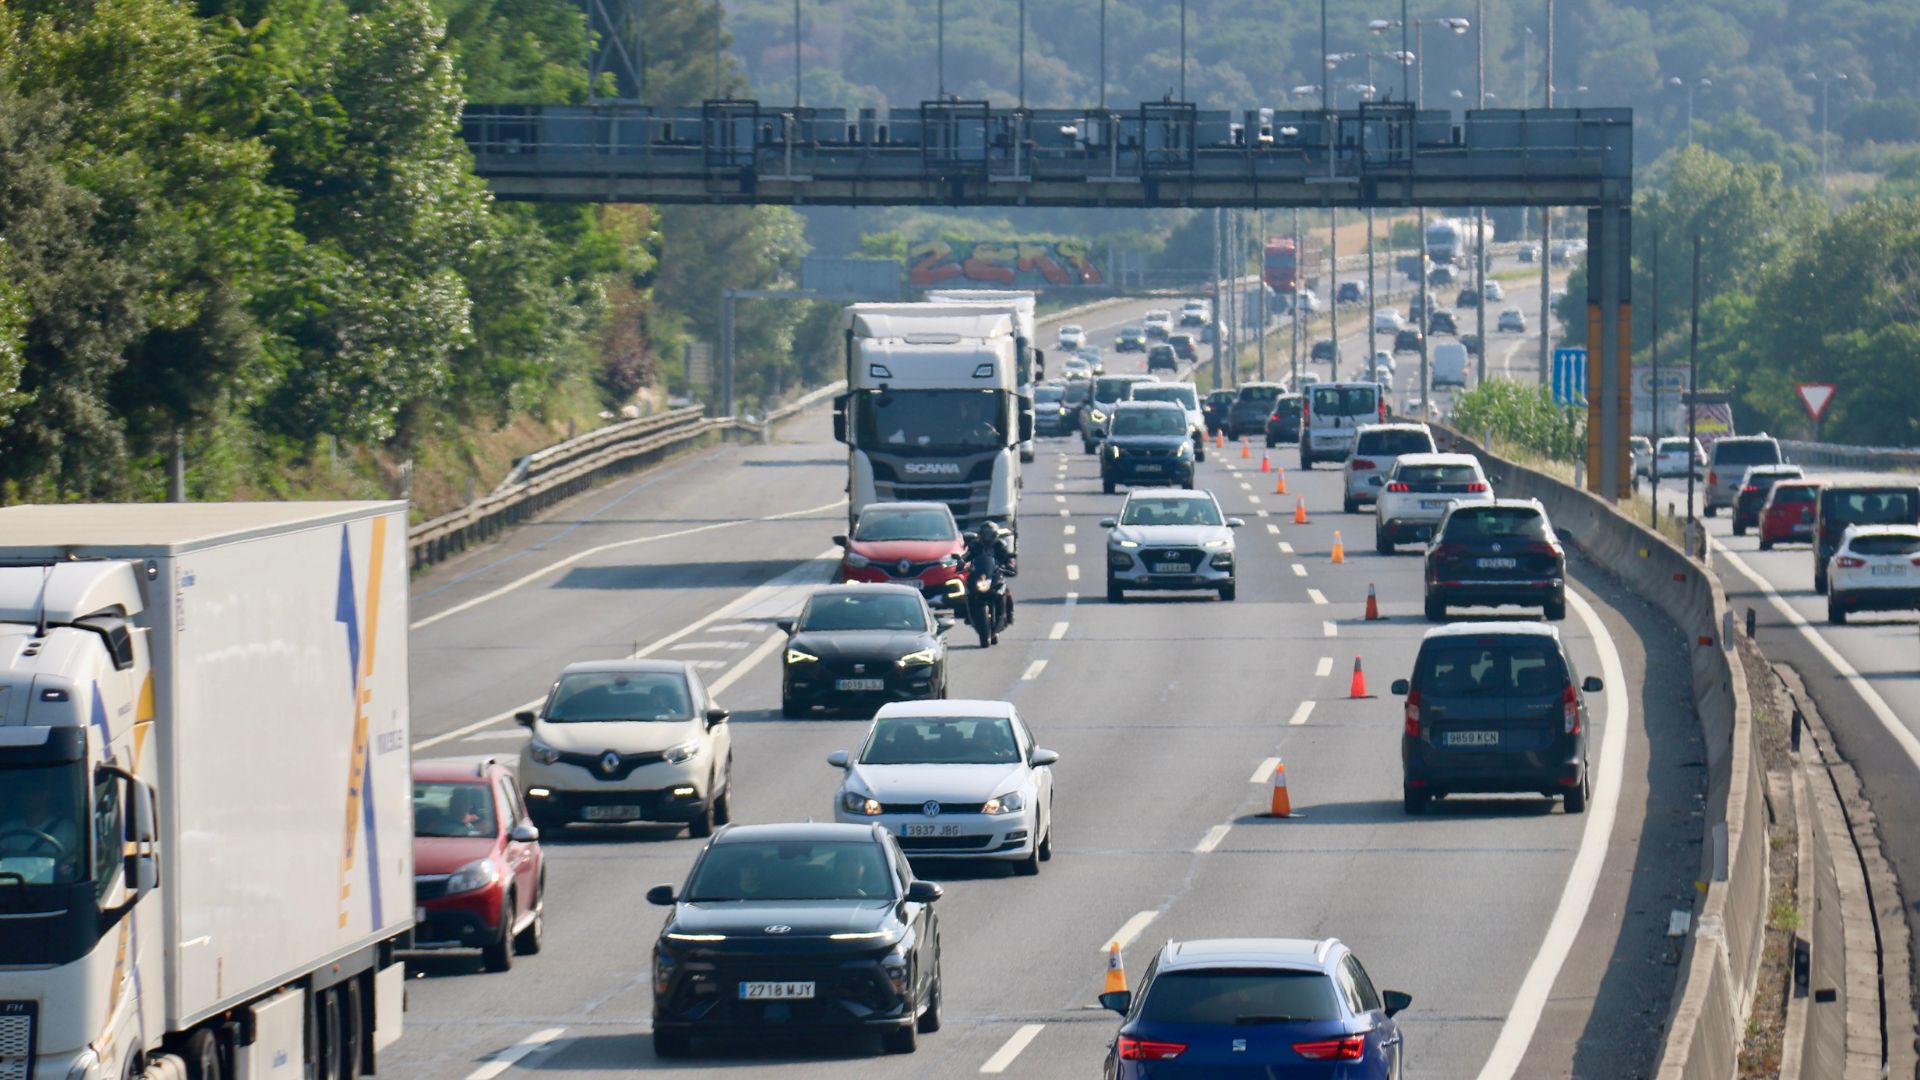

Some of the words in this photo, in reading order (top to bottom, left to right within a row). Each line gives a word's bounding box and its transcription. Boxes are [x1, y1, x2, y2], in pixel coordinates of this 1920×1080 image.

[904, 463, 960, 474] SCANIA
[1450, 733, 1475, 743] 9859
[1477, 733, 1497, 743] KCN
[909, 824, 935, 836] 3937
[939, 824, 959, 836] JBG
[749, 984, 782, 997] 2718
[786, 984, 811, 996] MJY
